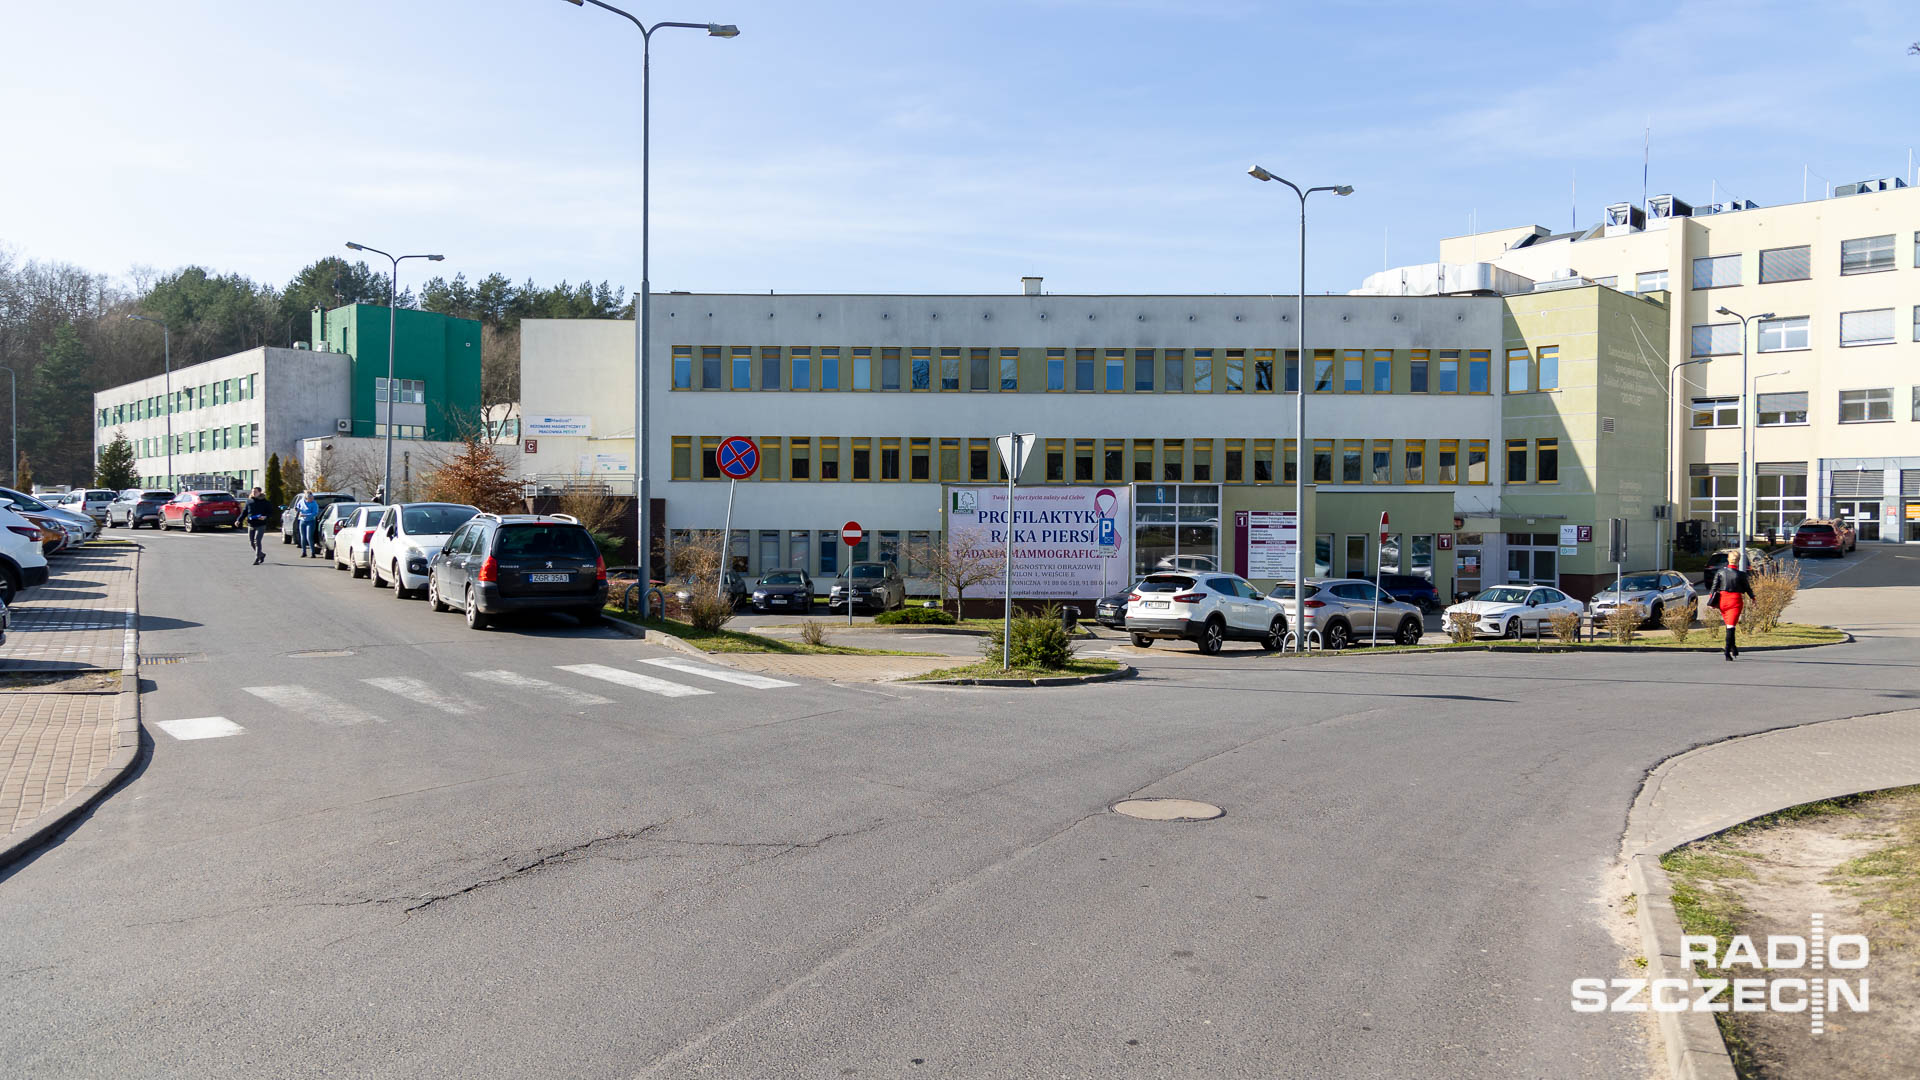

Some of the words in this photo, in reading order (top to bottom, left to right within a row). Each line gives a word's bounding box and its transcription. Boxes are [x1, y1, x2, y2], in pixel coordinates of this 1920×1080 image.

[978, 511, 1105, 523] PROFILAKTYKA
[1239, 517, 1244, 526] 1
[1102, 520, 1111, 537] P
[1042, 530, 1094, 542] PIERSI
[1012, 550, 1117, 558] MAMMOGRAFICZE
